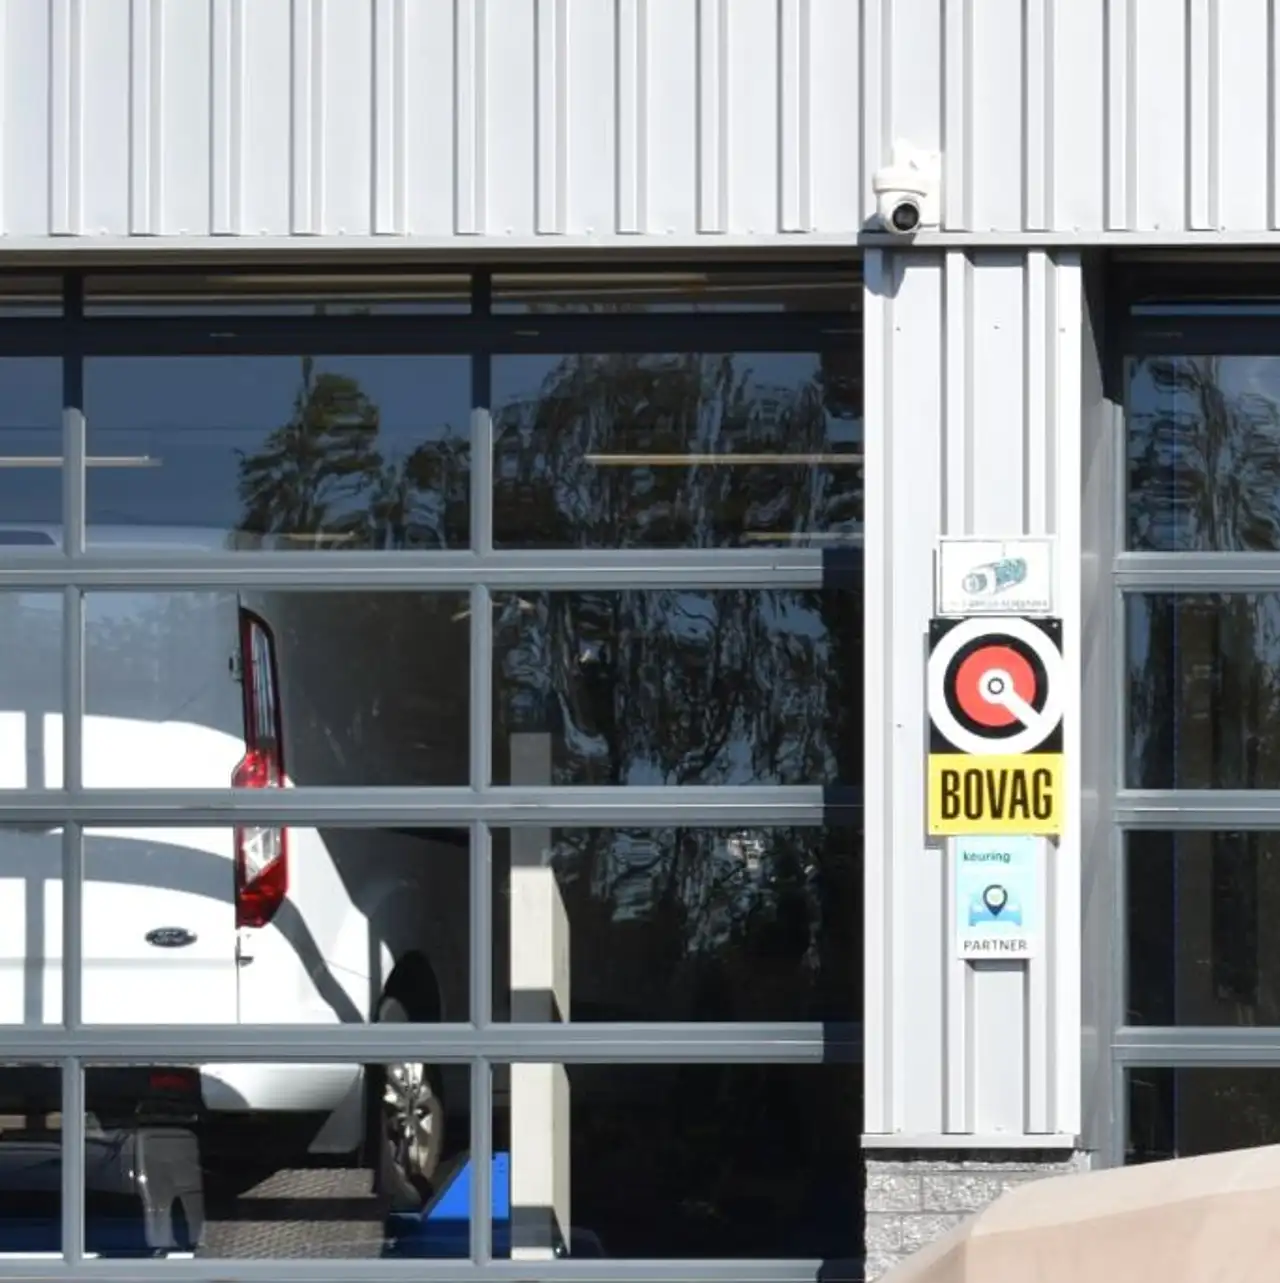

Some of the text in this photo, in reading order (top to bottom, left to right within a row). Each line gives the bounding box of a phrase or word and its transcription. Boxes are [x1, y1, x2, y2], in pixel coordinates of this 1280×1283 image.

[941, 768, 1053, 820] BOVAG
[963, 851, 1011, 864] keuring
[963, 939, 1028, 951] PARTNER
